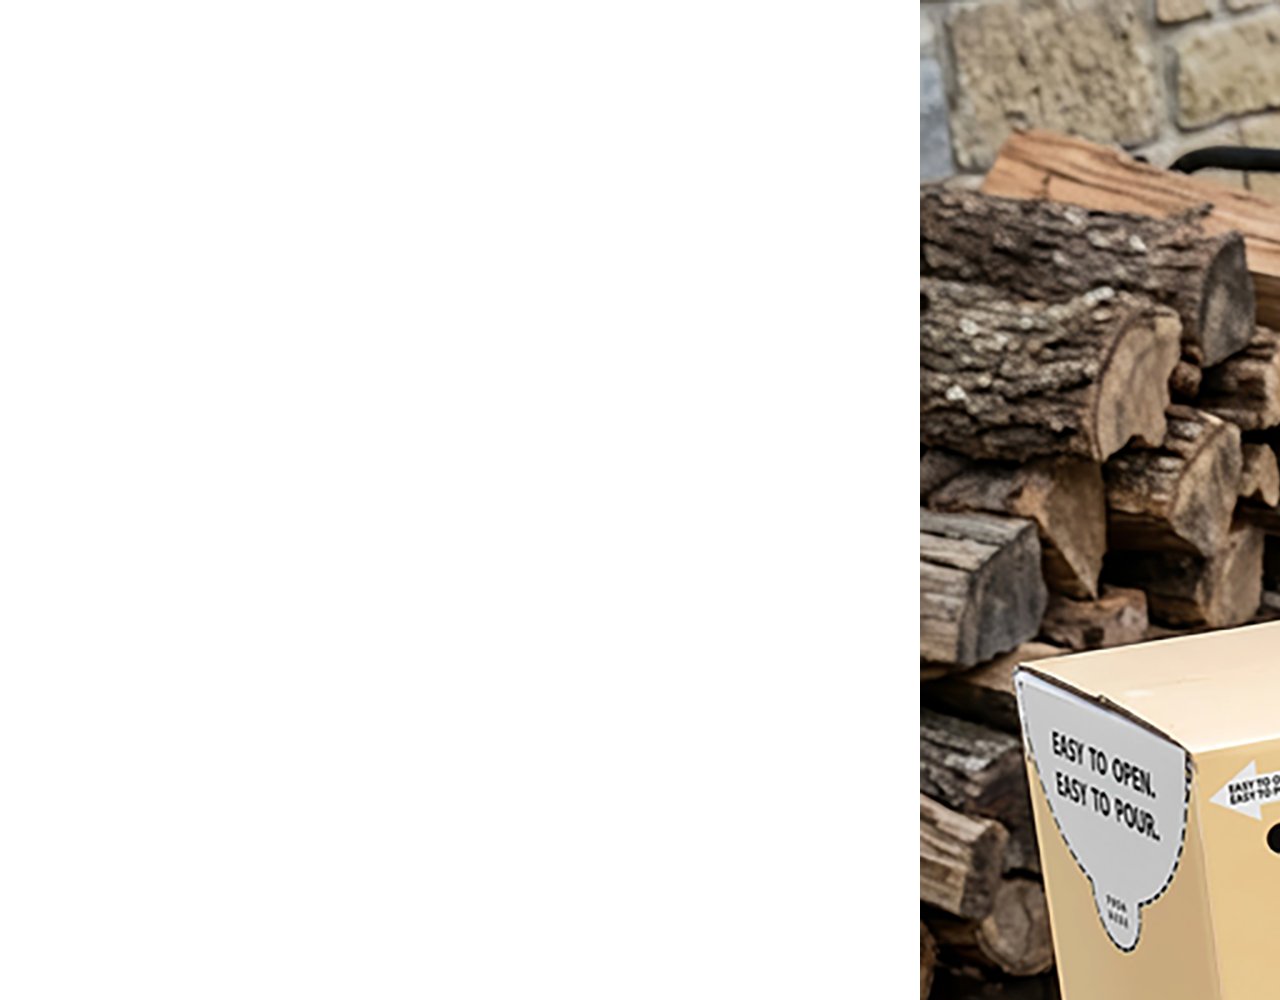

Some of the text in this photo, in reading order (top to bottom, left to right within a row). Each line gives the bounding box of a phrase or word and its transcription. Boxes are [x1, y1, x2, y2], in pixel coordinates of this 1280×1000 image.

[1051, 730, 1157, 799] EASY TO OPEN.
[1055, 771, 1161, 842] EASY TO POUR.
